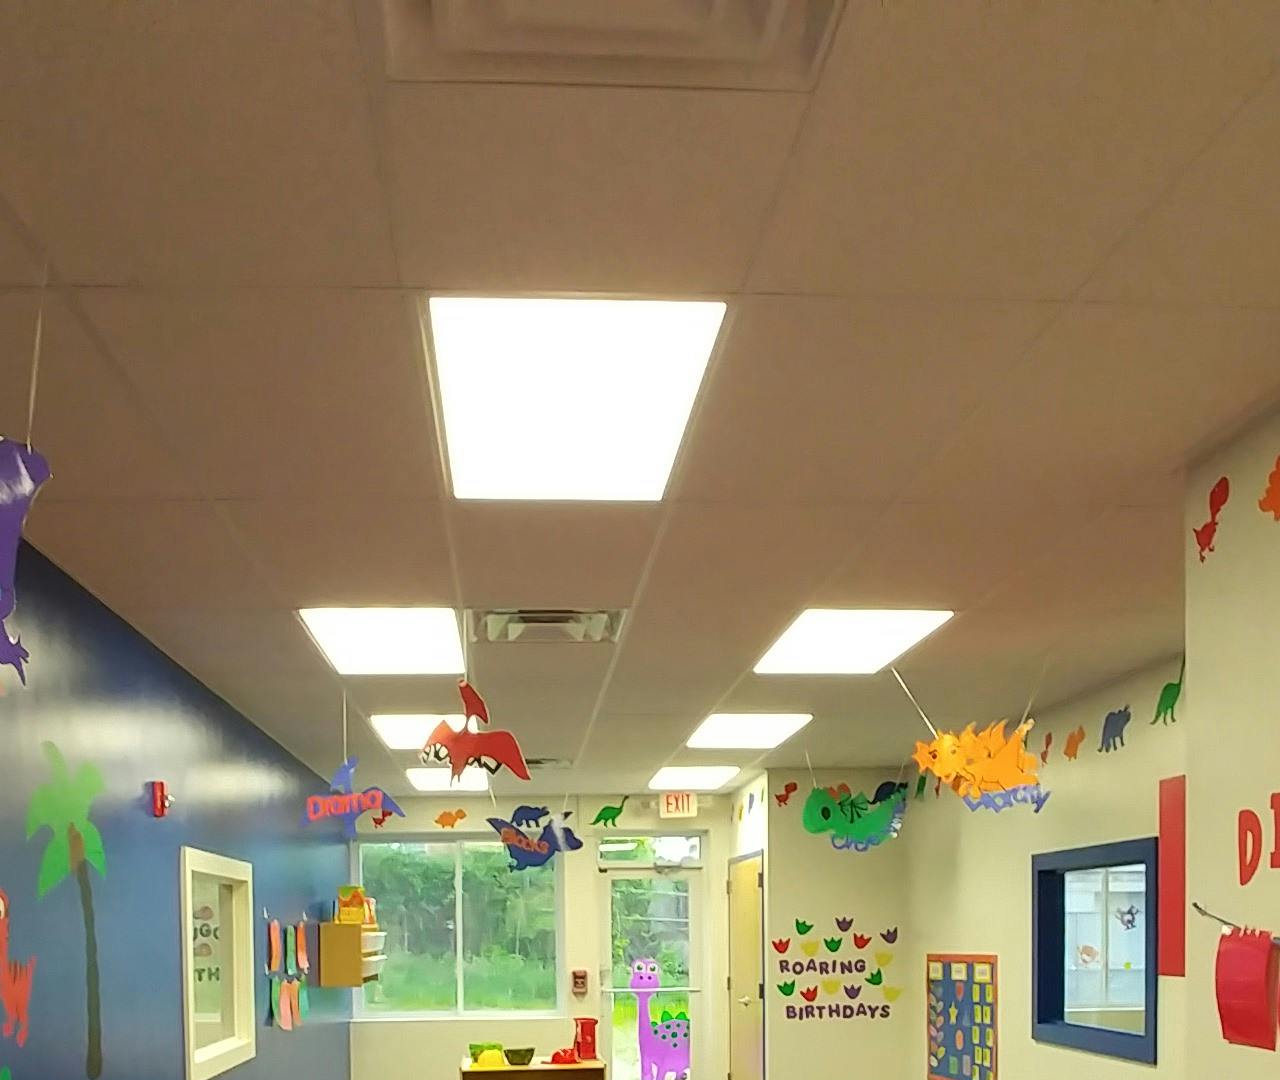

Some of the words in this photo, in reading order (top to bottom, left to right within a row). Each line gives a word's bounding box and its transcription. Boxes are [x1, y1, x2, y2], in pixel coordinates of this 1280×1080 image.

[306, 789, 383, 822] Drama
[666, 793, 691, 814] EXIT
[779, 958, 866, 976] ROARING
[785, 1002, 891, 1022] BIRTHDAYS
